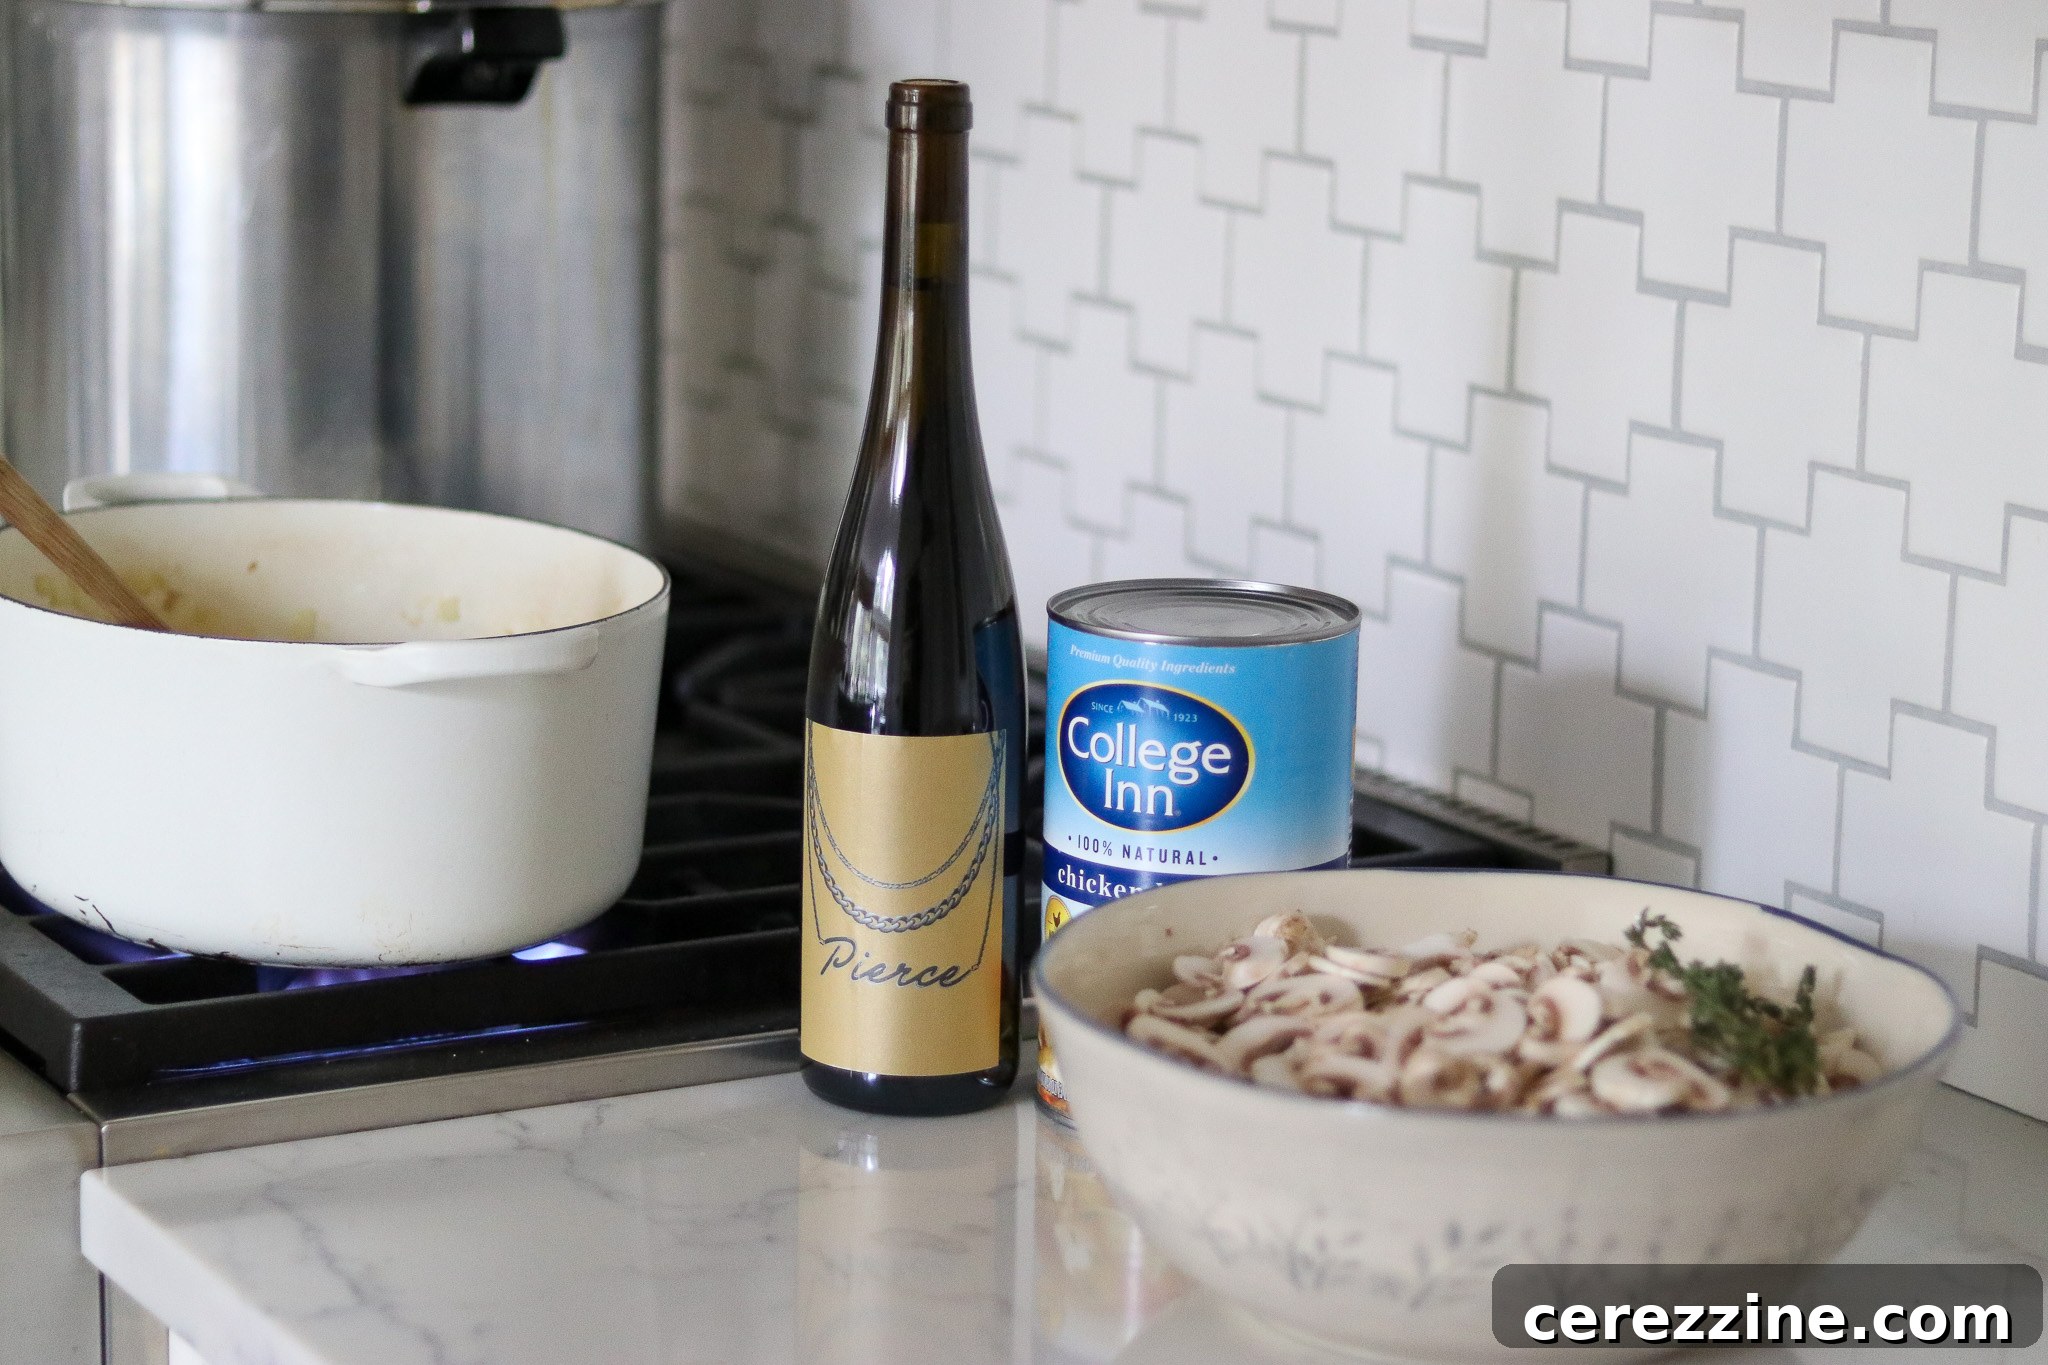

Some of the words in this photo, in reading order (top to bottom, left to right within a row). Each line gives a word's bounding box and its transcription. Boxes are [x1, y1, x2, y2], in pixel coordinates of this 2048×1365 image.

[1070, 644, 1111, 664] Premium
[1113, 654, 1158, 672] Quality
[1161, 660, 1236, 675] Ingredients
[1091, 701, 1114, 714] SINCE
[1173, 712, 1198, 723] 1923
[1067, 716, 1232, 785] College
[1103, 767, 1175, 817] Inn
[1077, 834, 1113, 857] 100%
[1122, 844, 1207, 866] NATURAL
[821, 936, 972, 988] Pierce
